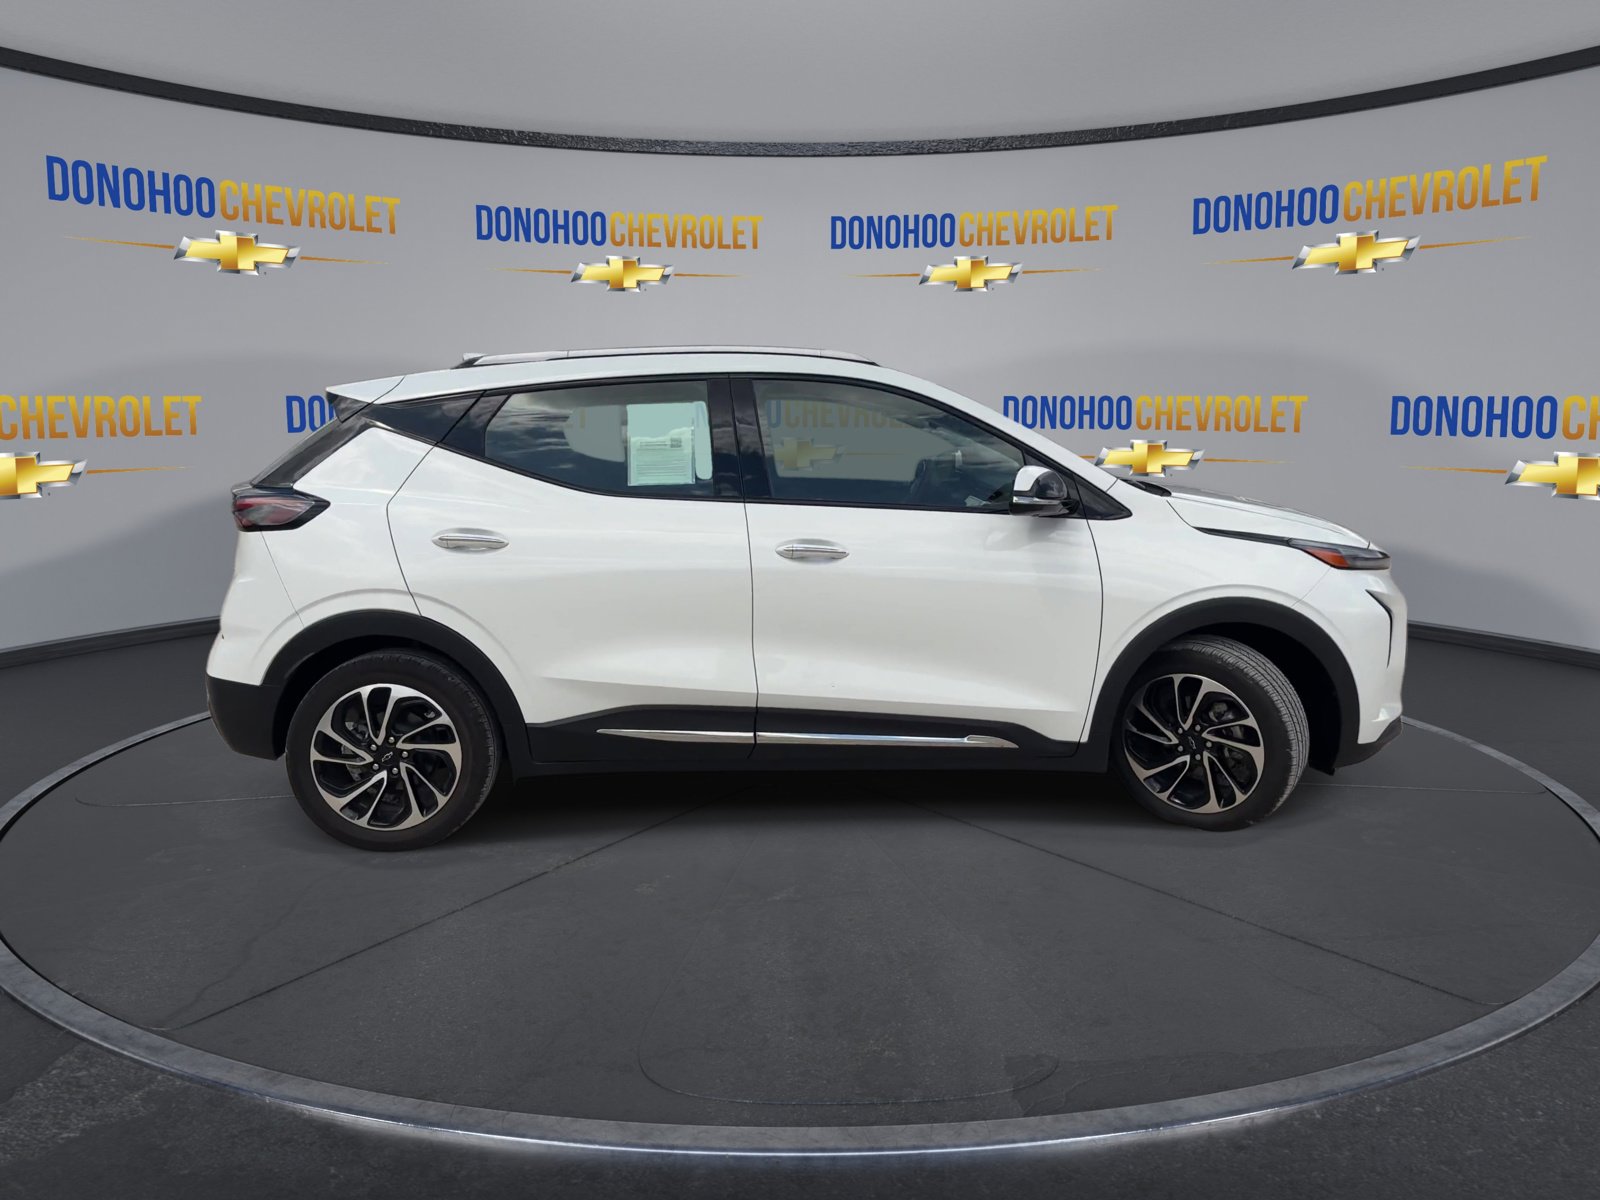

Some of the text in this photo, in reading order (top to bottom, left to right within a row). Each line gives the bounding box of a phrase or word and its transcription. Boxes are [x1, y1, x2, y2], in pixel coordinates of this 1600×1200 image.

[45, 155, 401, 235] DONOHOO CHEVROLET
[1192, 154, 1549, 235] DONOHOO CHEVROLET
[475, 204, 764, 250] DONOHOO CHEVROLET
[830, 204, 1119, 250] DONOHOO CHEVROLET
[0, 394, 203, 441] CHEVROLET
[1135, 394, 1309, 433] CHEVROLET
[1390, 395, 1558, 440] DONOHOO
